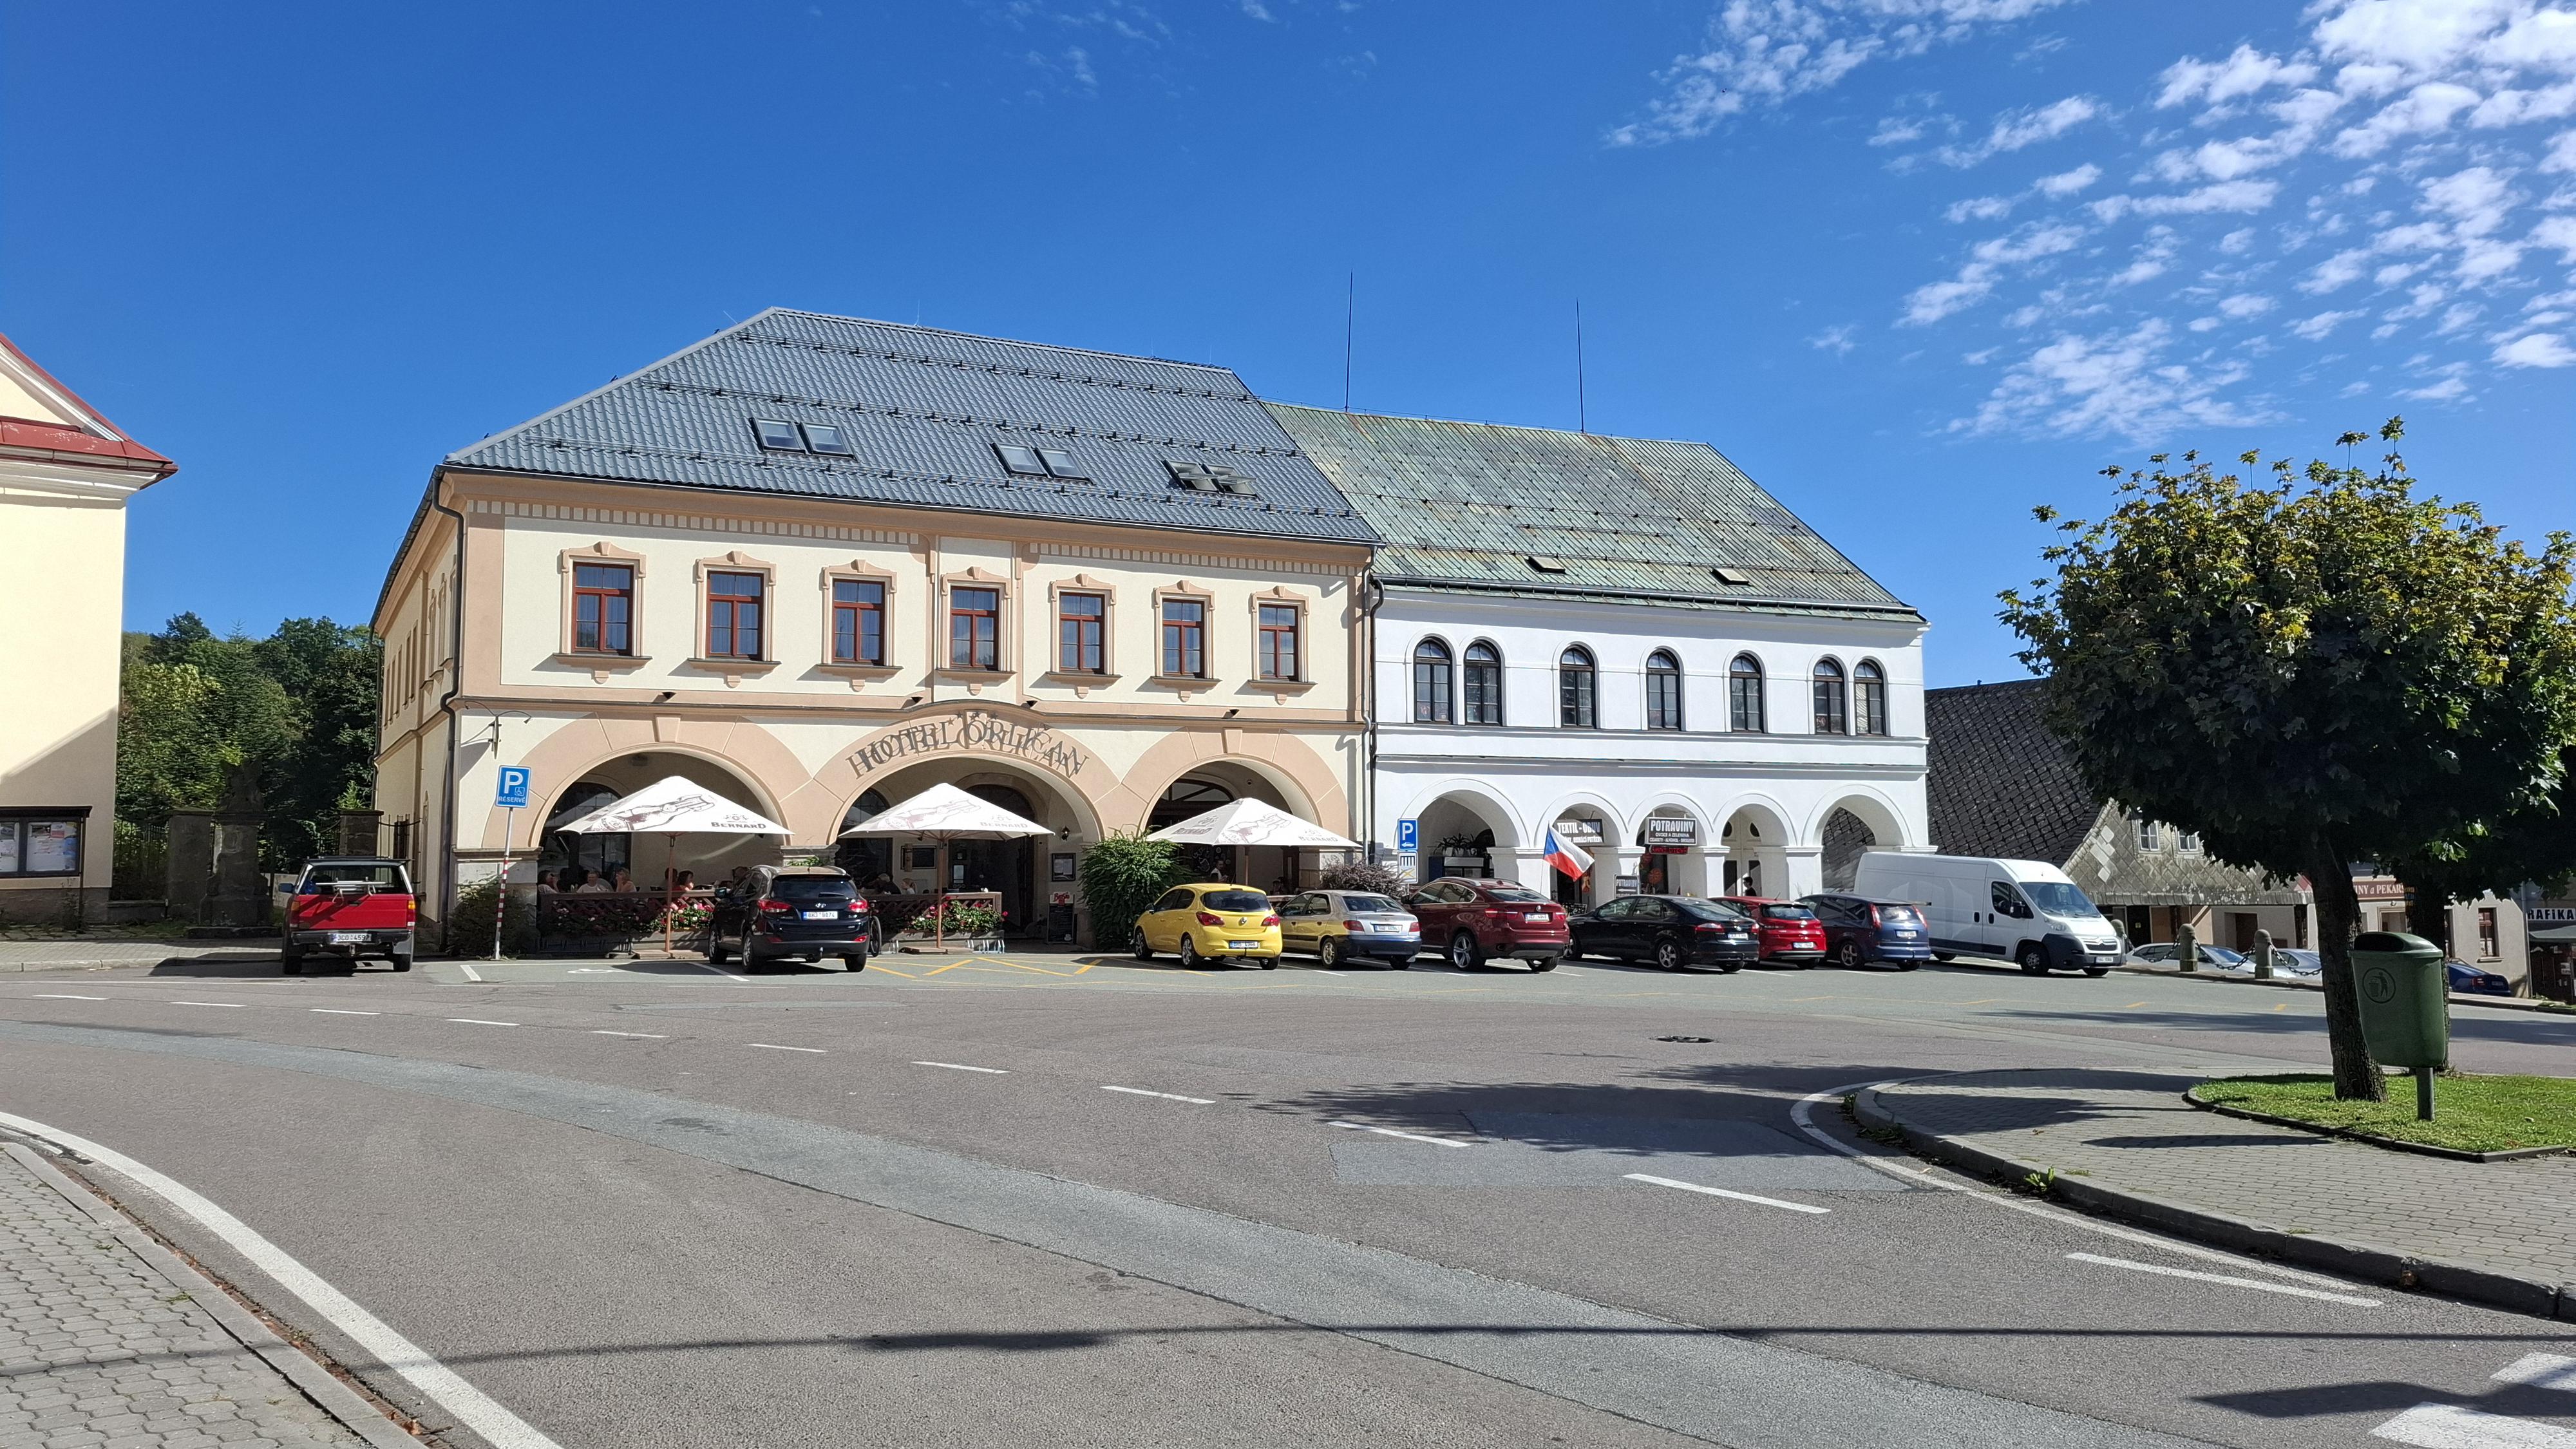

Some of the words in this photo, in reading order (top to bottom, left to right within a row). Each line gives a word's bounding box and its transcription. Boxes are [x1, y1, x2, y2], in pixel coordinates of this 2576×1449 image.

[851, 721, 959, 775] HOTEL
[504, 771, 523, 794] P
[1401, 822, 1414, 840] P
[1557, 822, 1579, 834] TEXTIL
[1582, 822, 1600, 833] OBUV
[1651, 820, 1694, 832] POTRAVINY
